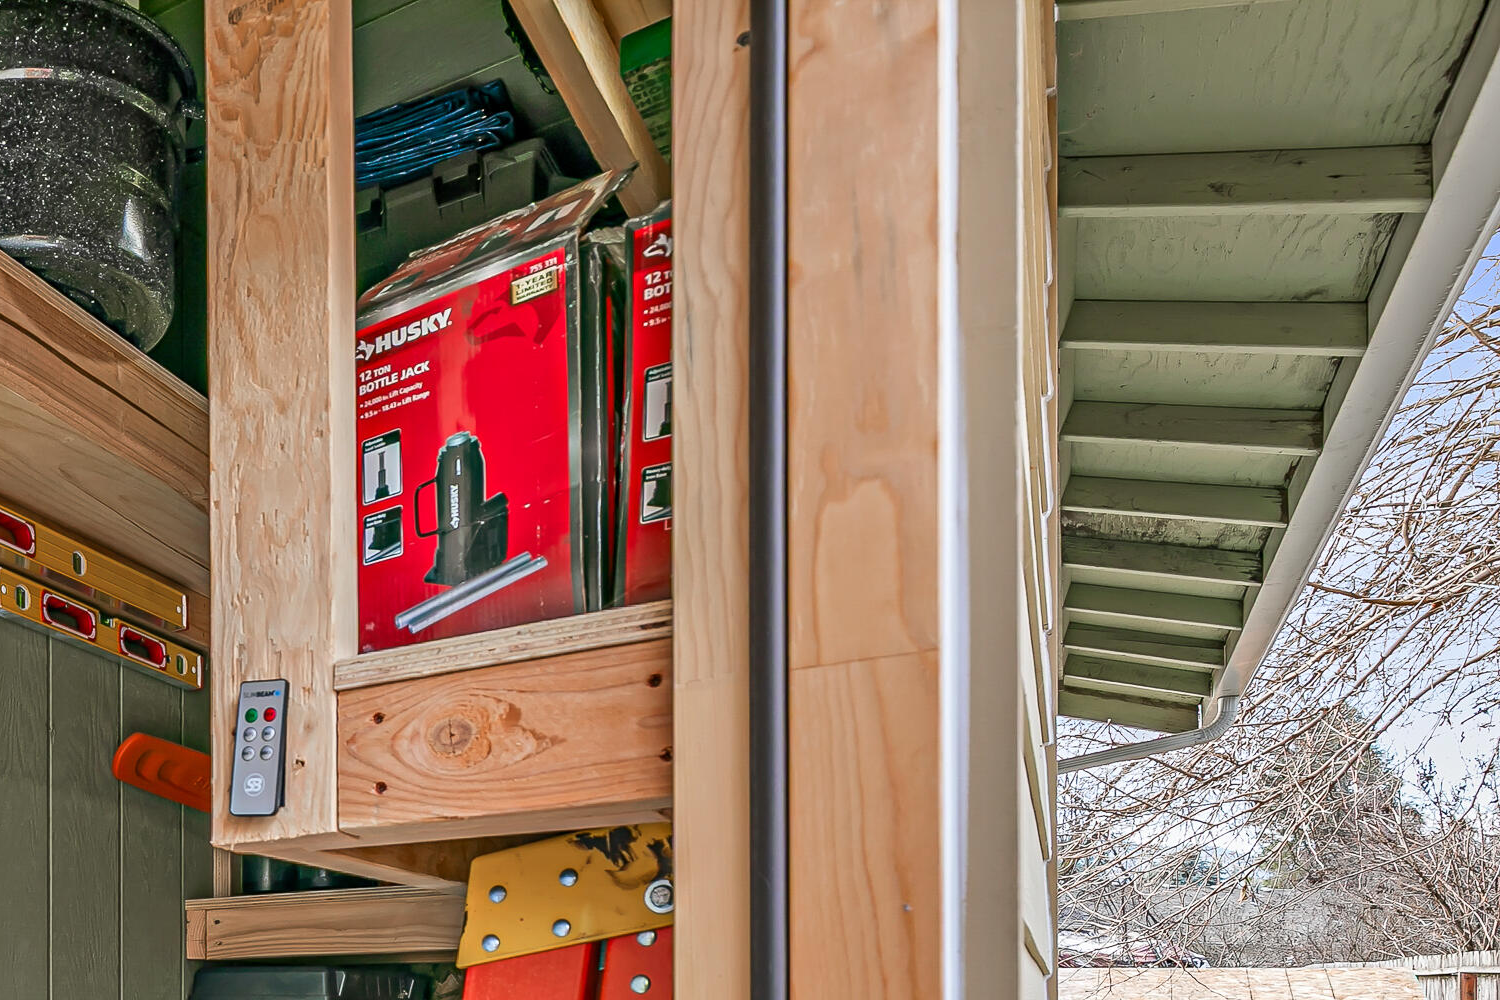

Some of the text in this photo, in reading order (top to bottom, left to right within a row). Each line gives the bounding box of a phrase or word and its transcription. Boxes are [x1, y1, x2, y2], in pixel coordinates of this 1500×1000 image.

[516, 278, 553, 296] LIMITED
[644, 271, 662, 286] 12
[359, 364, 392, 382] 12 TON
[359, 360, 430, 396] BOTTLE JACK
